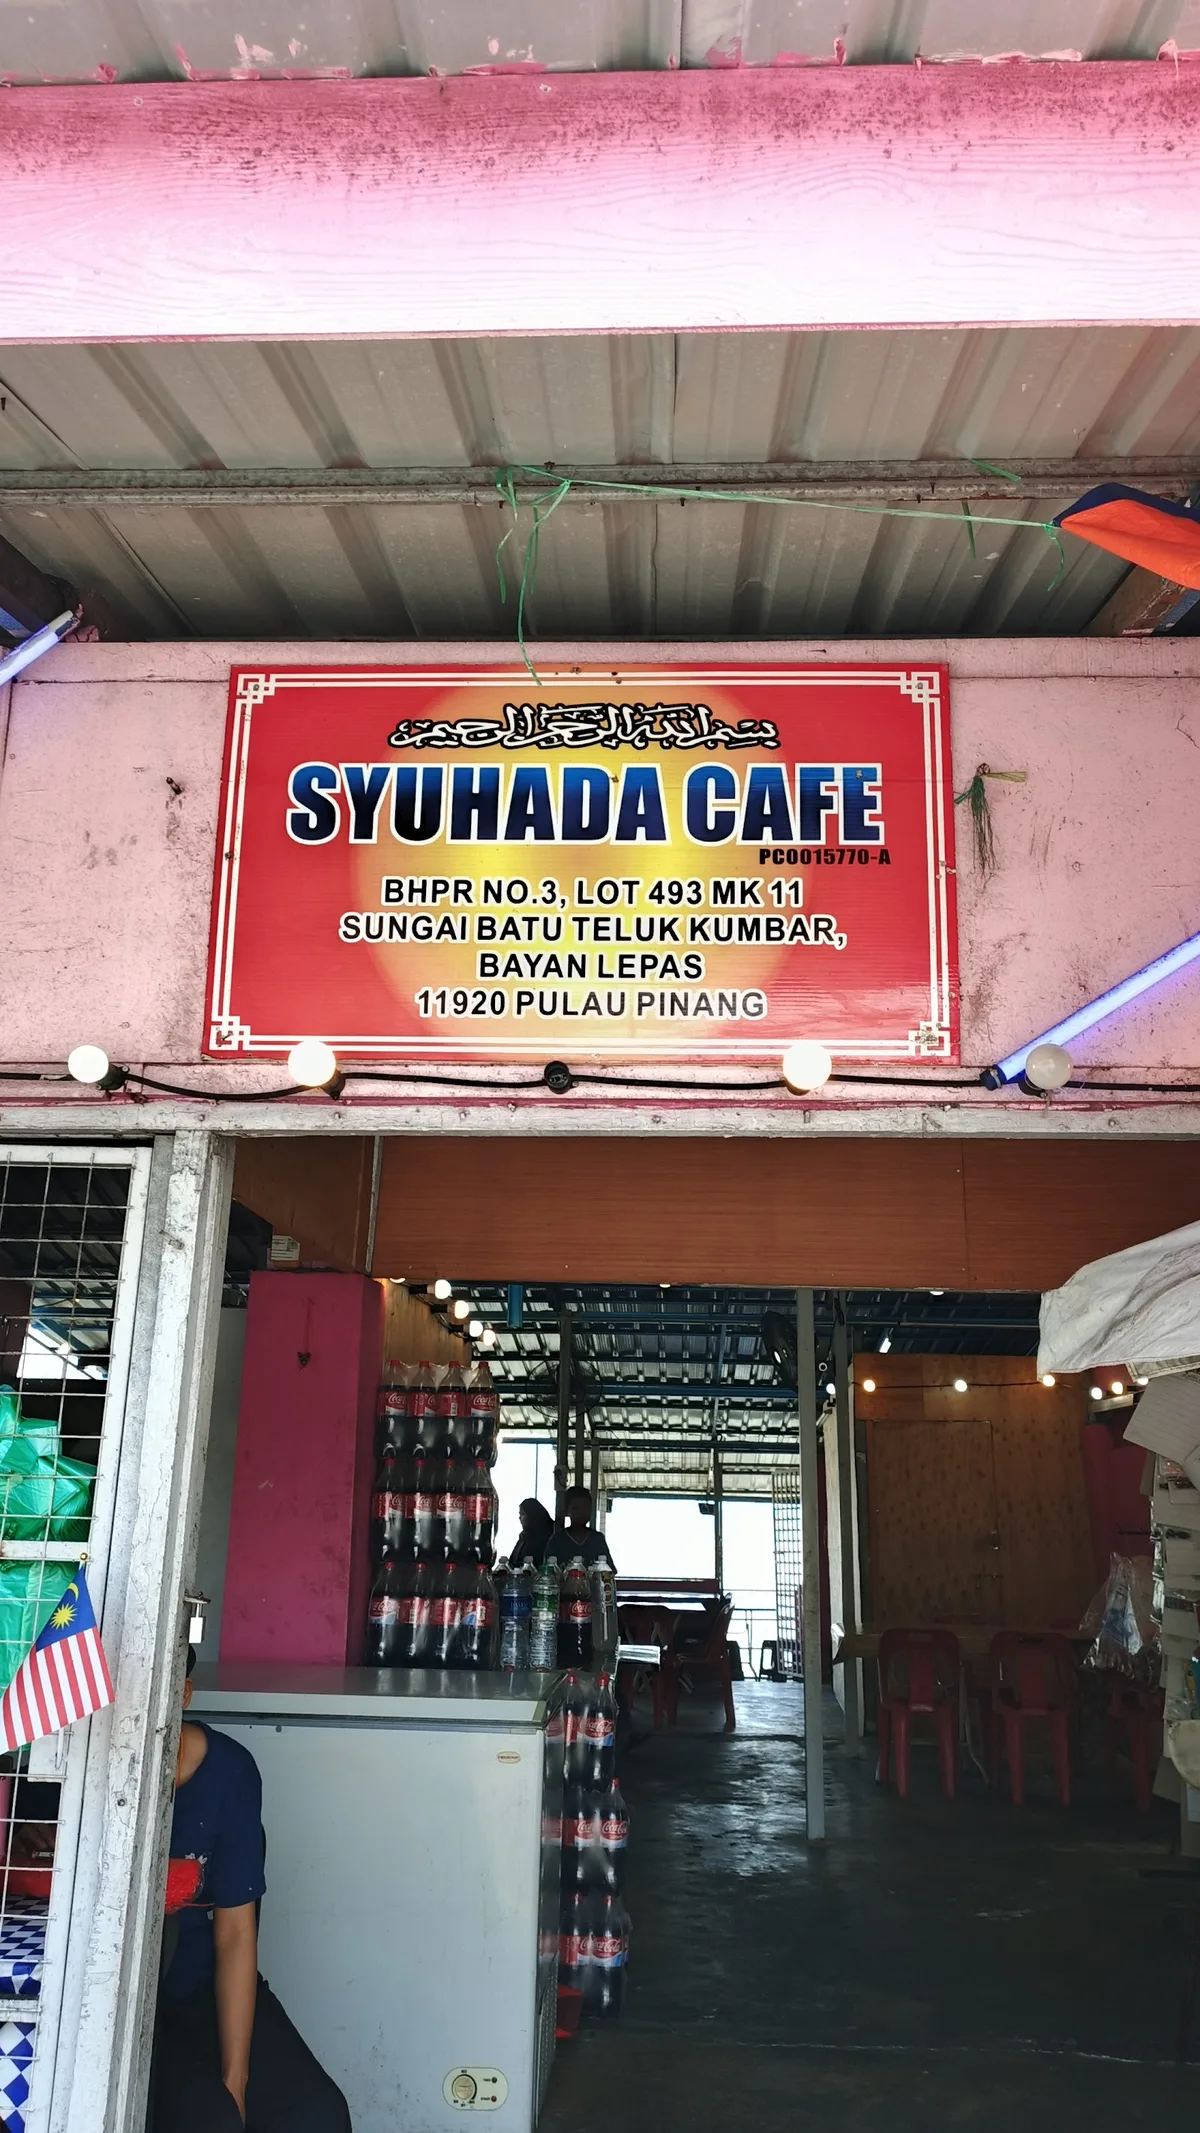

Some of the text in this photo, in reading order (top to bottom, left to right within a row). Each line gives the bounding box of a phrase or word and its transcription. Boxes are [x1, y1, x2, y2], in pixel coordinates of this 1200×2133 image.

[287, 762, 885, 846] SYUHADA CAFE
[382, 879, 803, 909] BHPR NO.3, LOT 493 MK 11
[338, 914, 848, 950] SUNGAI BATU TELUK KUMBAR,
[479, 953, 704, 980] BAYAN LEPAS
[416, 989, 765, 1018] 11920 PULAU PINANG
